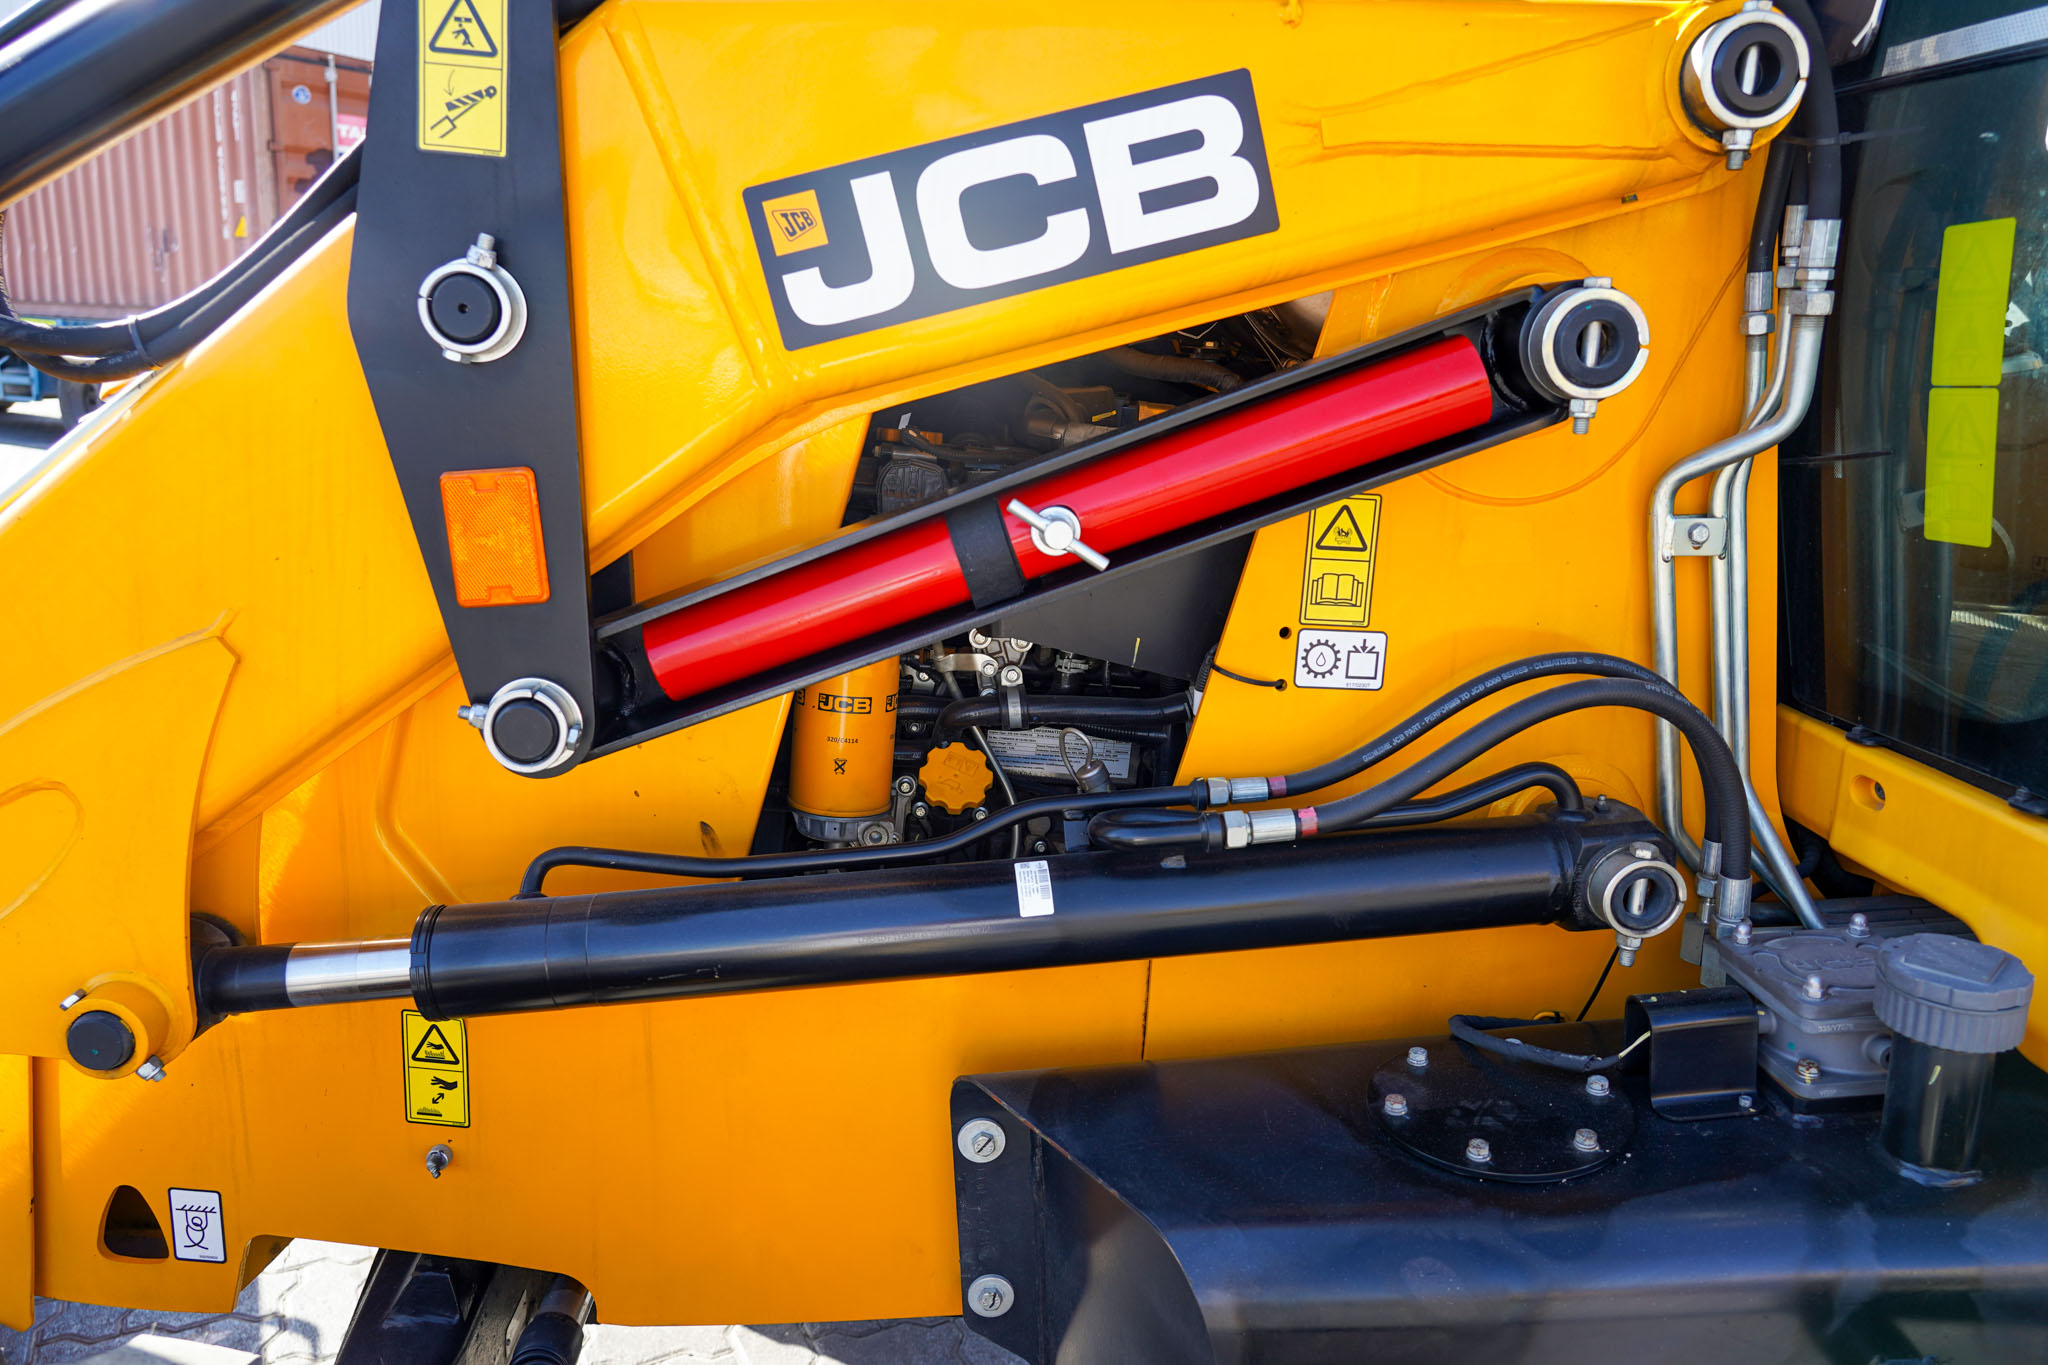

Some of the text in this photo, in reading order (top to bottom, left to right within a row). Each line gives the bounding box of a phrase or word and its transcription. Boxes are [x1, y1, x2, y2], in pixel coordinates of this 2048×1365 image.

[780, 211, 814, 237] JCB
[782, 95, 1260, 325] JCB
[819, 694, 871, 713] JCB
[1392, 734, 1405, 745] JCB
[1405, 722, 1421, 737] PART
[1424, 697, 1460, 724] PERFORMS
[1460, 691, 1470, 701] TO
[1471, 684, 1485, 696] JCB
[1501, 666, 1528, 680] SERIES
